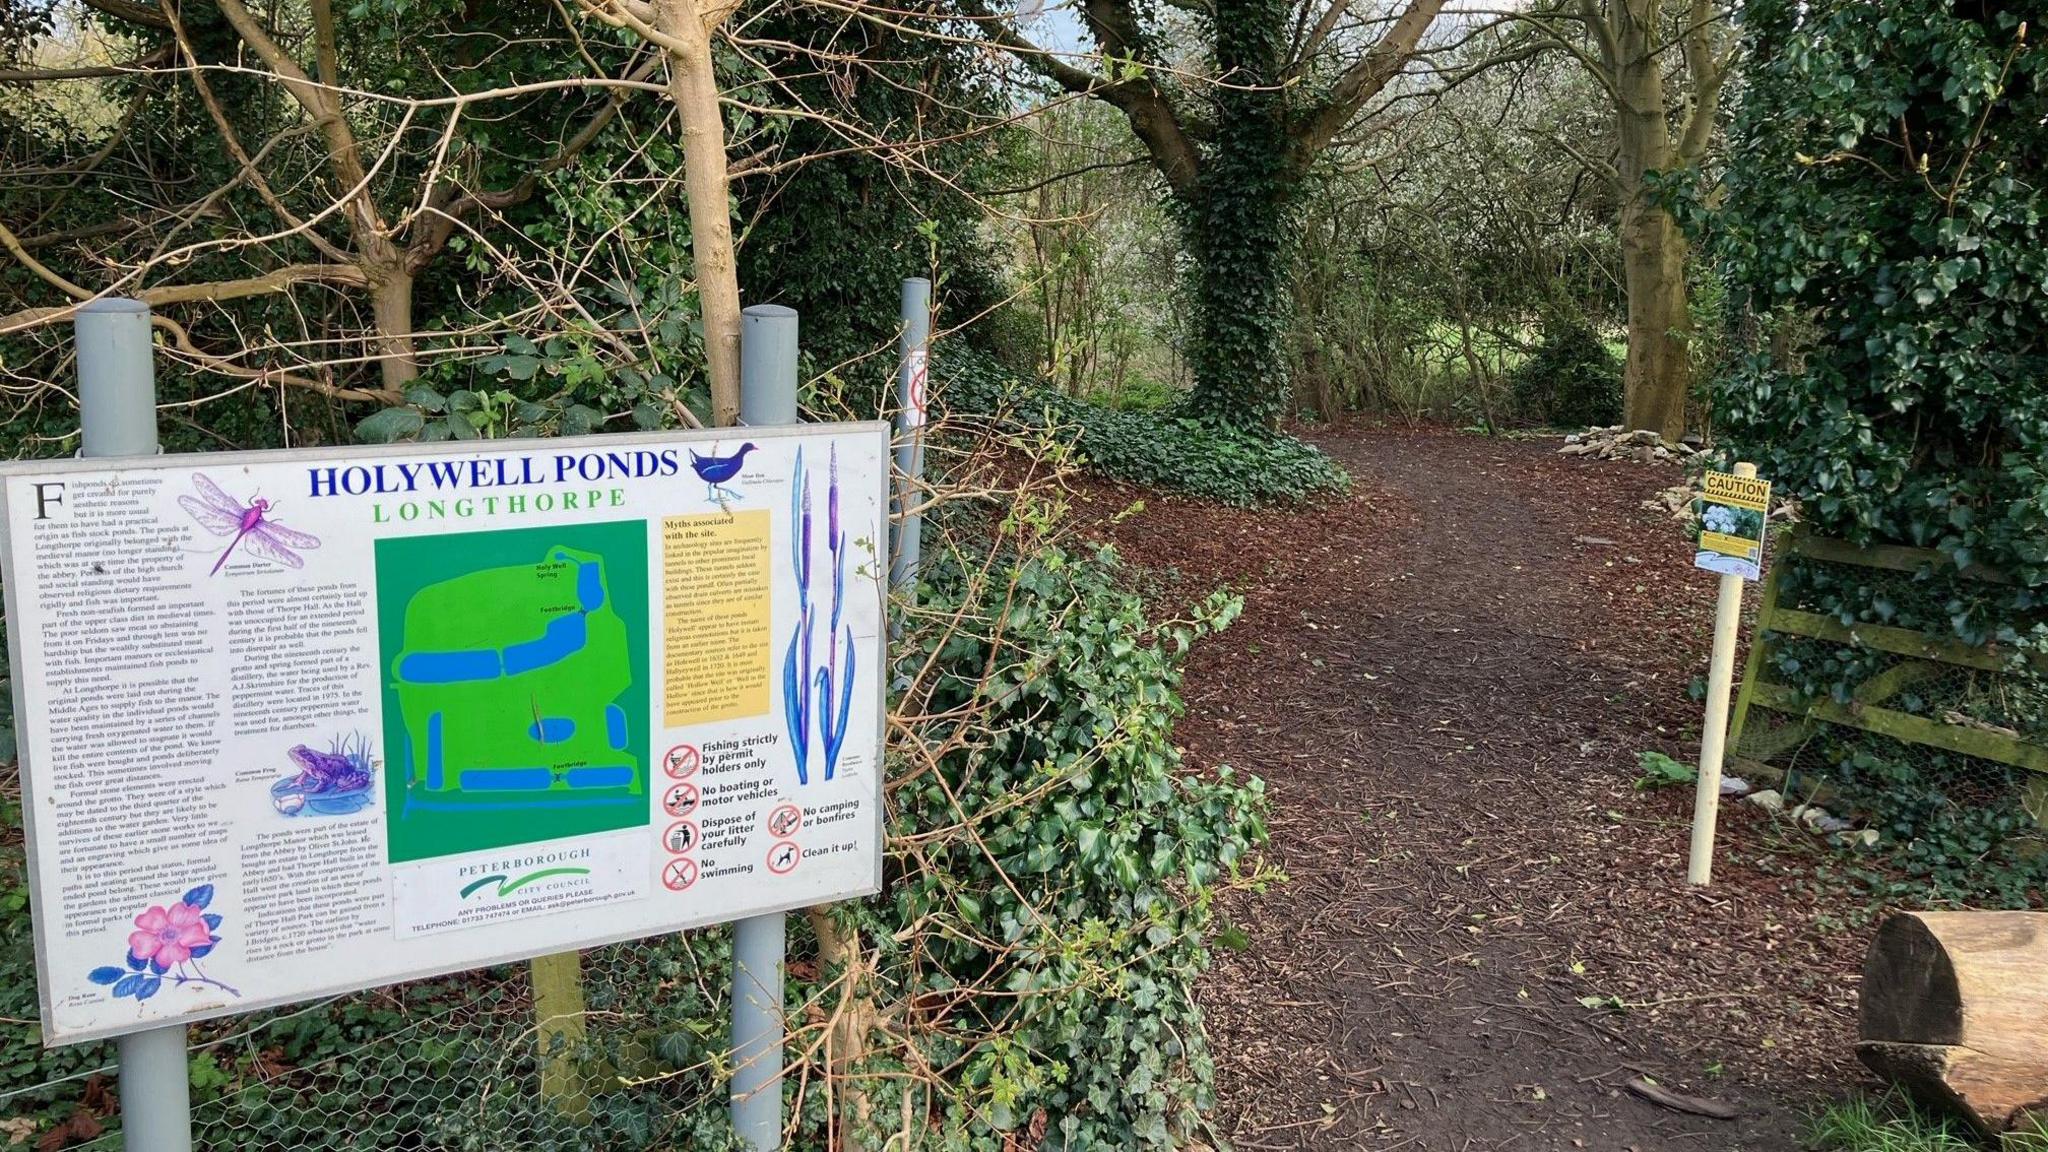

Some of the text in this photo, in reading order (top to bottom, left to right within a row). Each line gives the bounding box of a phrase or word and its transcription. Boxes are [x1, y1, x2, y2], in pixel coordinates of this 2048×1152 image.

[307, 448, 678, 498] HOLYWELL PONDS
[1708, 477, 1766, 496] CAUTION
[32, 482, 66, 520] F
[373, 487, 626, 523] LONGTHORPE
[665, 516, 733, 530] Myths associated
[664, 528, 717, 540] with the site.
[702, 732, 777, 754] Fishing strictly
[702, 748, 753, 766] by permit
[702, 757, 765, 775] holders only
[702, 777, 773, 795] No boating or
[702, 786, 777, 807] motor vehicles
[803, 797, 859, 816] No camping
[701, 811, 755, 830] Dispose of
[803, 809, 855, 827] or bonfires
[701, 822, 754, 841] your litter
[701, 835, 746, 850] carefully
[802, 840, 856, 858] Clean it up!
[459, 847, 589, 877] PETERBOROUGH
[701, 858, 714, 868] No
[701, 861, 753, 878] swimming
[517, 877, 589, 895] CITY COUNCIL
[457, 888, 593, 917] ANY PROBLEMS OR QUERIES PLEASE
[461, 914, 483, 924] 01733
[485, 909, 510, 920] 747474
